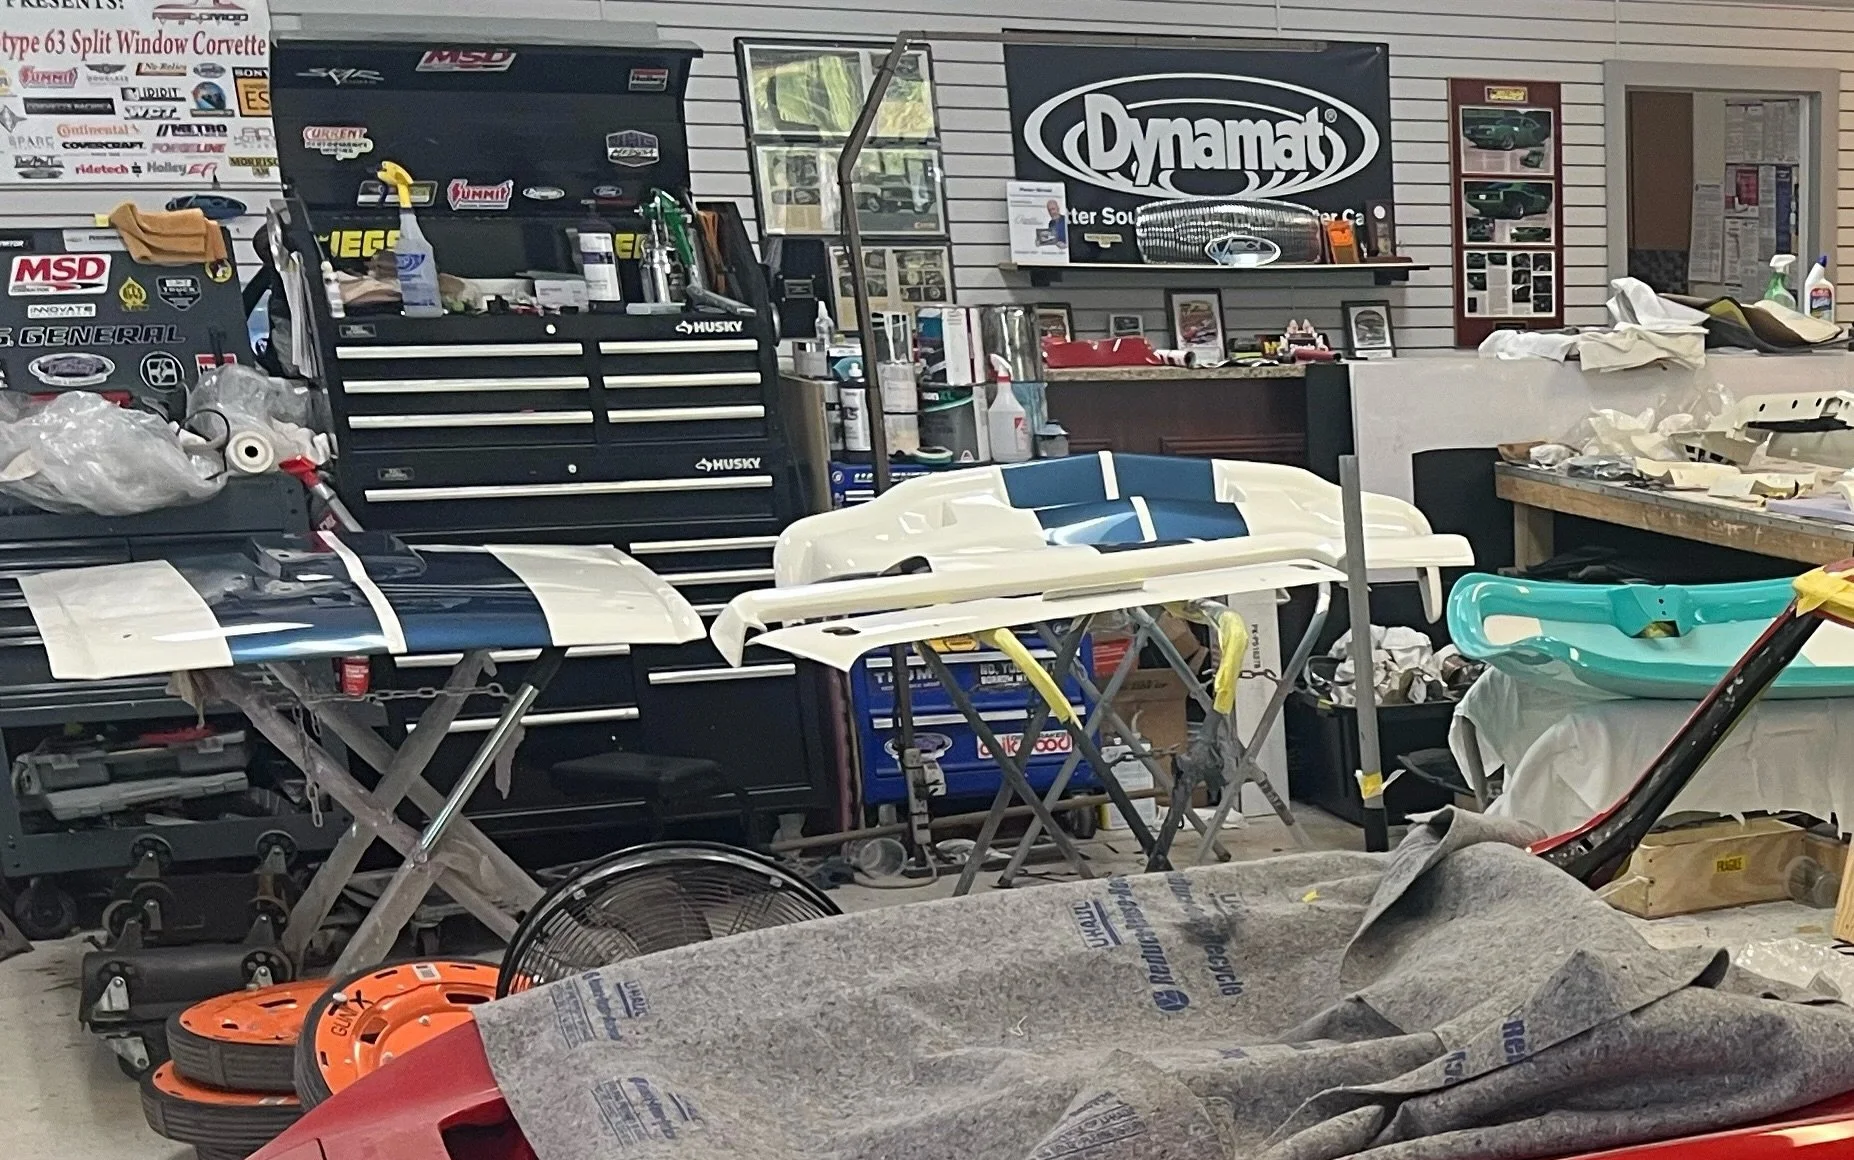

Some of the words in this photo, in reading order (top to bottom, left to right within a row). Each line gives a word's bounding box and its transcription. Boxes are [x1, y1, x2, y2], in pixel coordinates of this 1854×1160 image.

[45, 28, 65, 54] 63
[71, 28, 112, 61] Split
[117, 28, 188, 55] Window
[193, 30, 266, 56] Corvette
[424, 50, 512, 64] MSD
[1084, 93, 1328, 187] Dynamat
[147, 162, 187, 176] Holley
[15, 257, 106, 282] MSD
[19, 324, 186, 347] GENERAL
[693, 320, 743, 333] HUSKY
[712, 457, 761, 470] HUSKY
